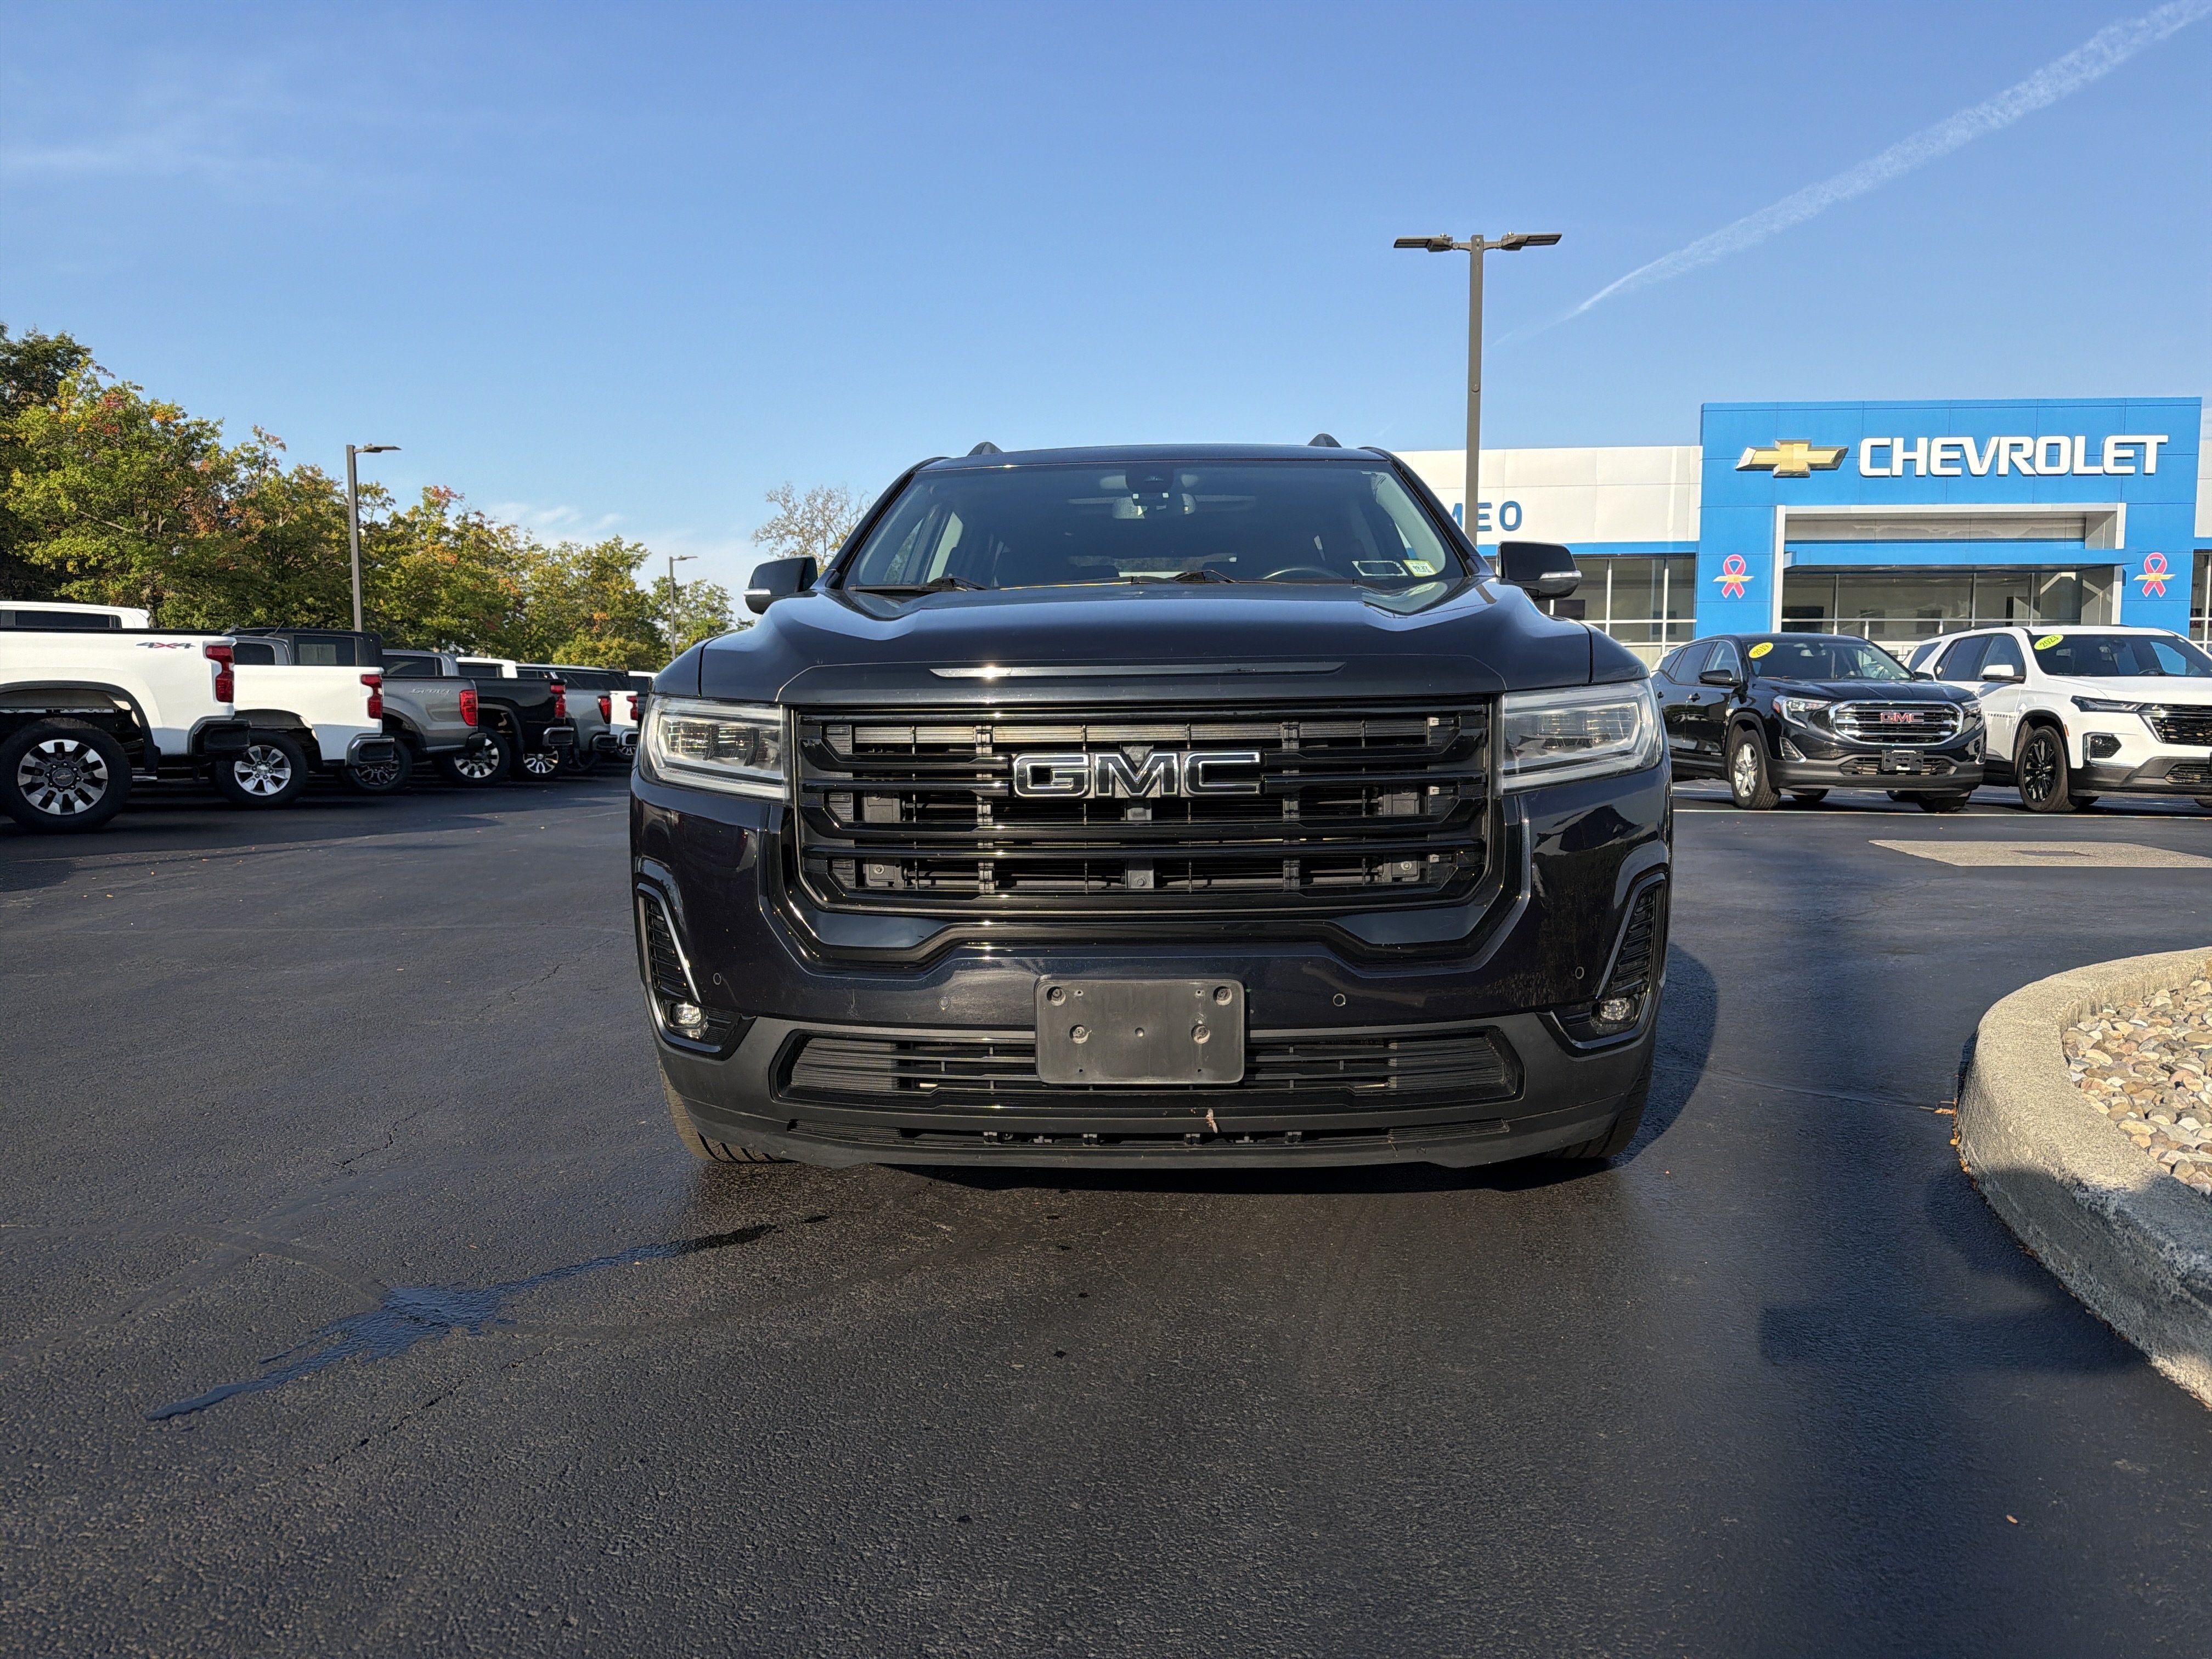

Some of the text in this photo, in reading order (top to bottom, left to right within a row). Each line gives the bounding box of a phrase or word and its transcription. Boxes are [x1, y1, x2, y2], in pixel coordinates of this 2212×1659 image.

[1859, 435, 2168, 476] CHEVROLET
[2040, 636, 2058, 647] 2023
[1753, 644, 1769, 655] 2019
[1880, 712, 1925, 724] GMC
[1013, 751, 1261, 798] GMC
